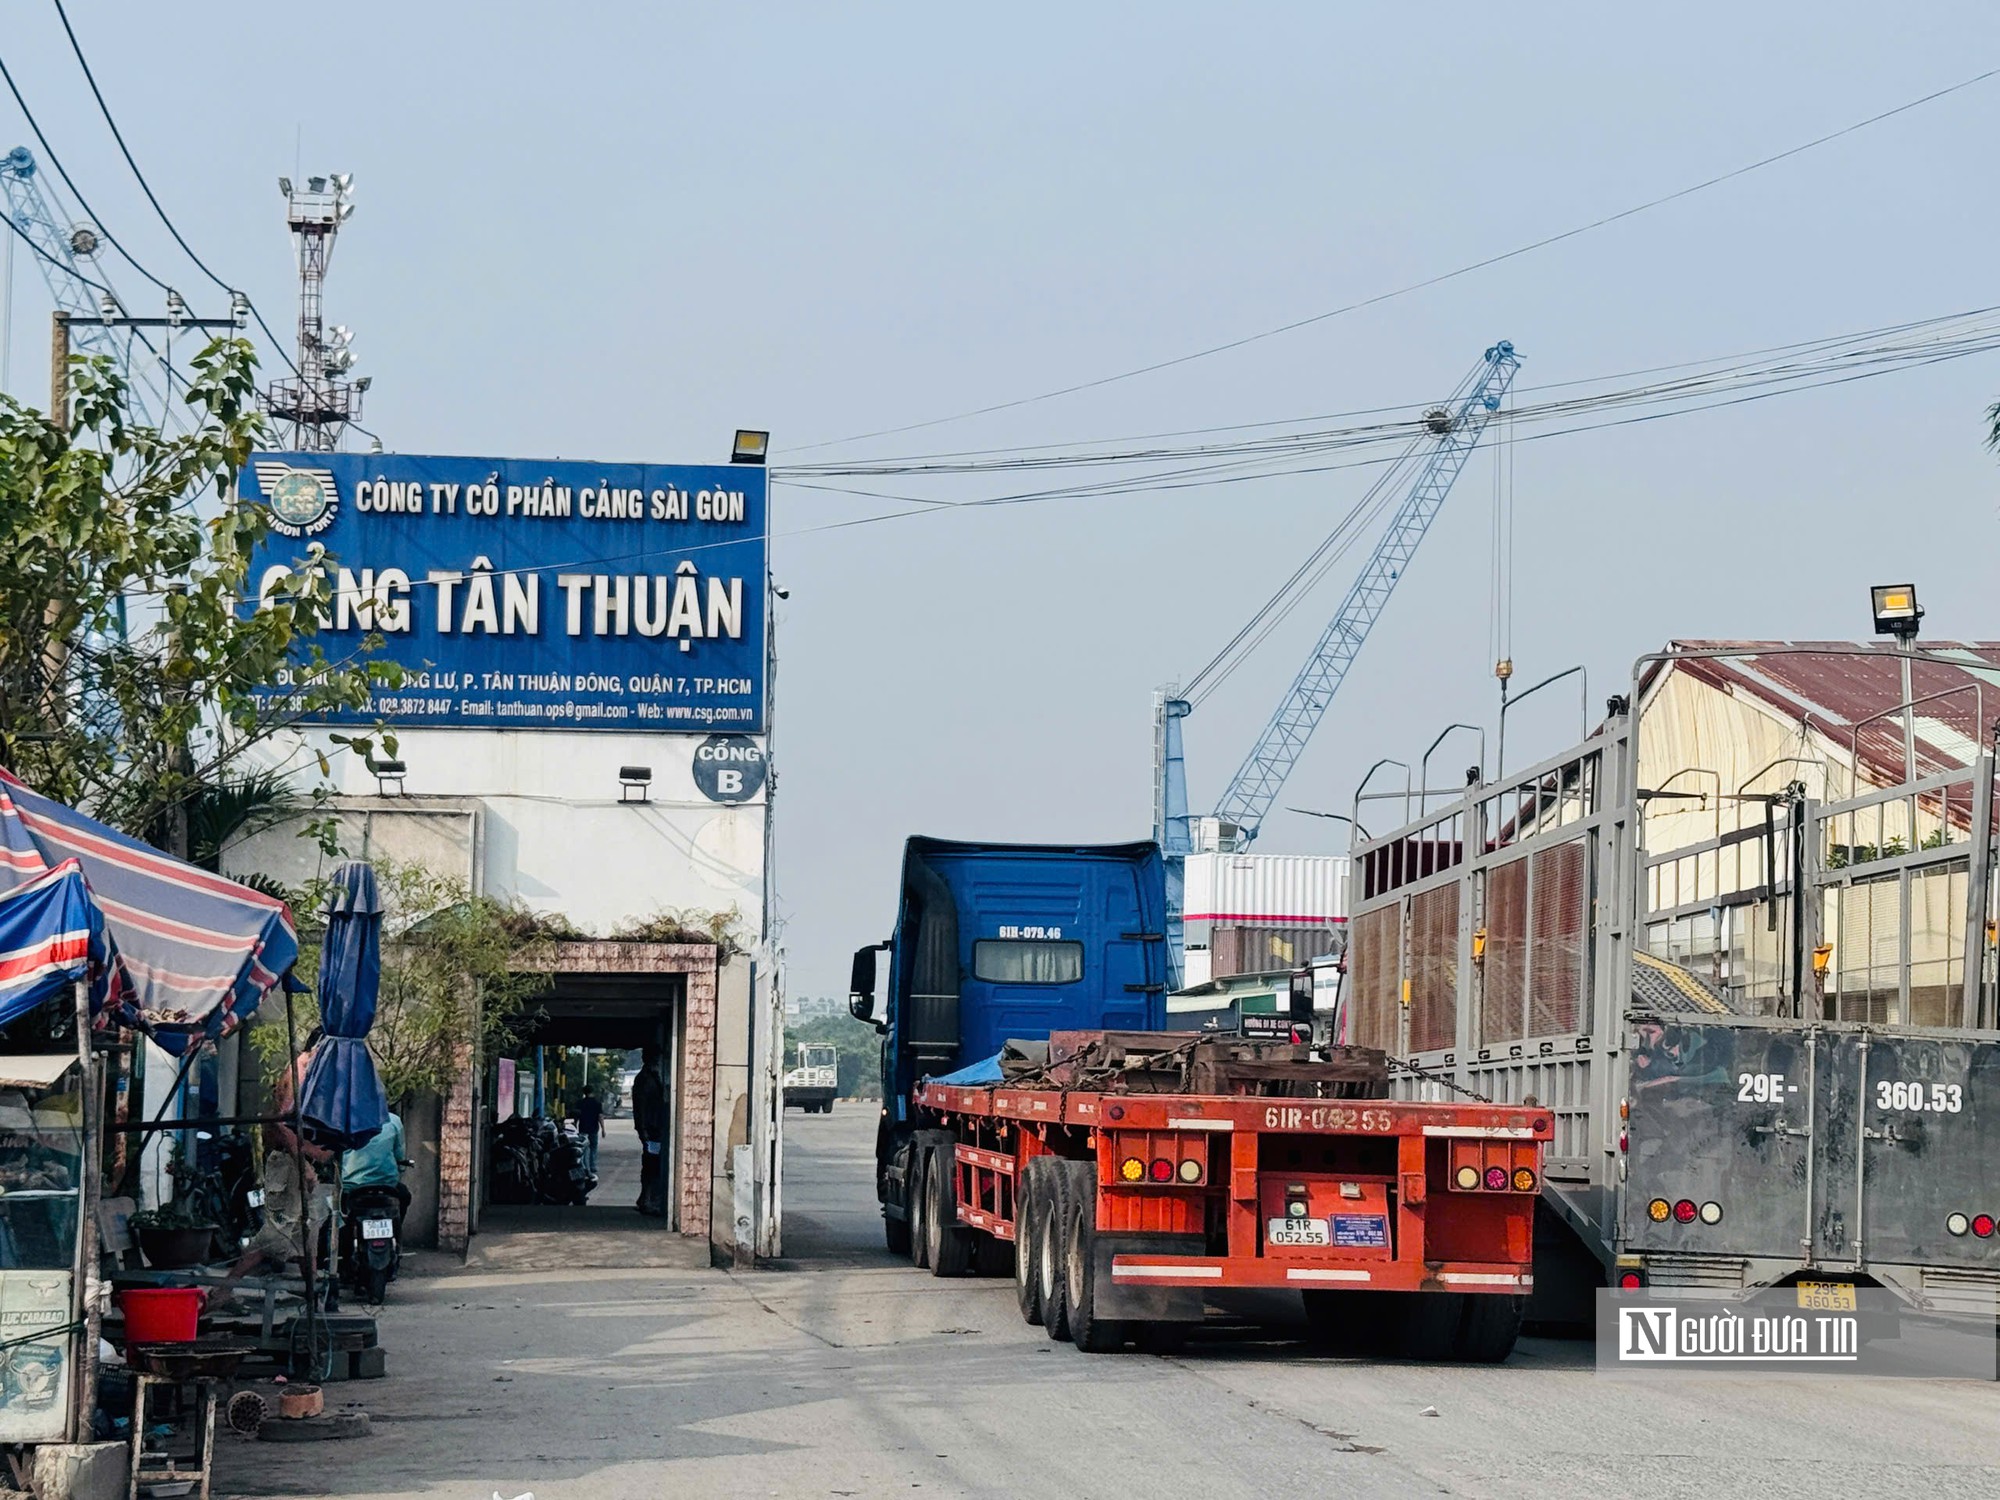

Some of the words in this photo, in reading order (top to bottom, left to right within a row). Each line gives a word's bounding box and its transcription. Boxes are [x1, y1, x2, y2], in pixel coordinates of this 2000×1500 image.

[356, 474, 422, 513] CÔNG
[430, 484, 460, 514] TY
[466, 471, 499, 516] CỔ
[507, 476, 572, 517] PHẦN
[579, 478, 644, 519] CẢNG
[650, 483, 689, 520] SÀI
[696, 484, 745, 521] GÒN
[265, 511, 301, 537] AIGON
[428, 555, 539, 635] TÂN
[557, 560, 743, 652] THUẬN
[463, 673, 478, 690] P.
[482, 670, 514, 691] TÂN
[518, 671, 571, 694] THUẬN
[575, 671, 625, 696] ĐÔNG,
[629, 673, 673, 695] QUẬN
[677, 677, 690, 697] 7,
[694, 678, 752, 695] TP.HCM
[428, 700, 451, 715] 8447
[461, 702, 495, 717] Email:
[497, 701, 628, 721] tanthuan.ops@gmail.com
[638, 703, 664, 719] Web:
[666, 705, 753, 724] www.csg.com.vn
[698, 738, 760, 762] CỔNG
[717, 769, 743, 794] B
[999, 925, 1062, 939] 61H-079.46
[1876, 1080, 1963, 1113] 360.53
[1285, 1219, 1312, 1231] 61R
[1276, 1231, 1324, 1244] 052.55
[1813, 1283, 1839, 1296] 29E
[1805, 1295, 1850, 1309] 360.53
